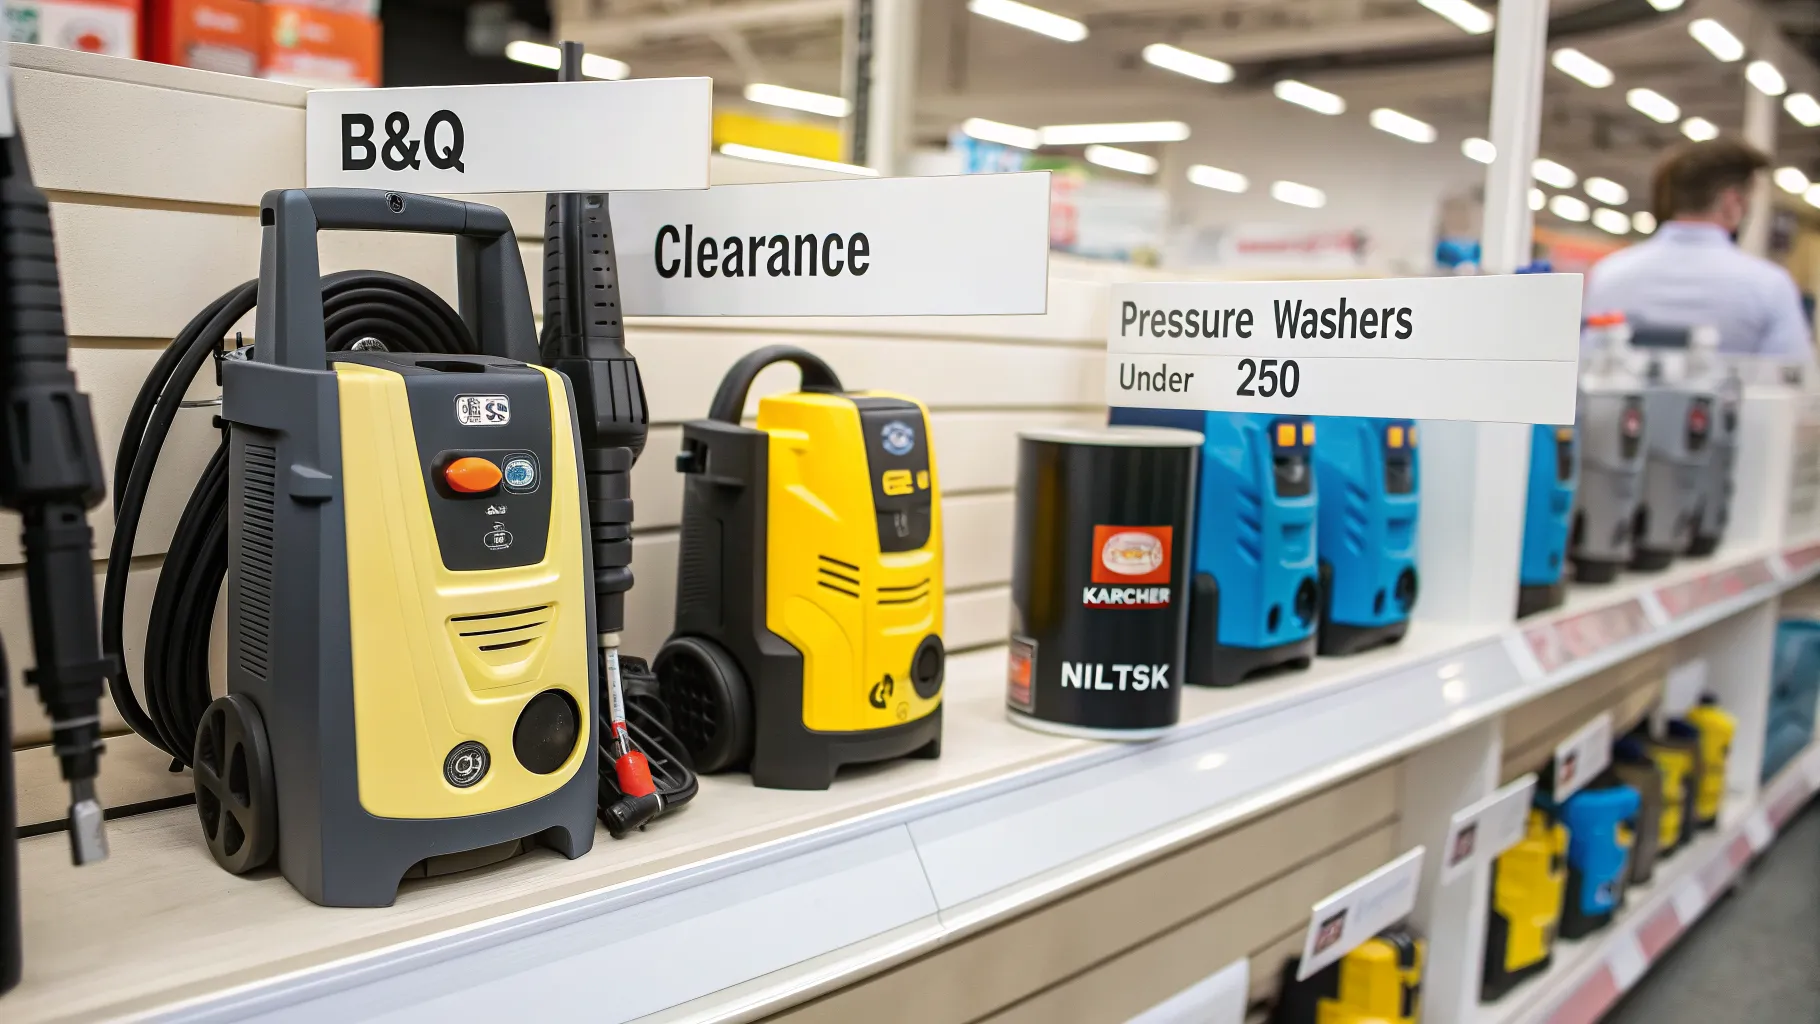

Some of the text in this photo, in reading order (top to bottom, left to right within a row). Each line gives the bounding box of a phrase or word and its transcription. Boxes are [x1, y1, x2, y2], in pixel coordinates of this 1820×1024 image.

[341, 109, 466, 174] B&Q
[654, 223, 871, 279] Clearance
[1120, 297, 1414, 340] Pressure Washers
[1119, 358, 1301, 399] Under 250
[1082, 586, 1171, 605] KARCHER
[1060, 661, 1170, 692] NILTSK
